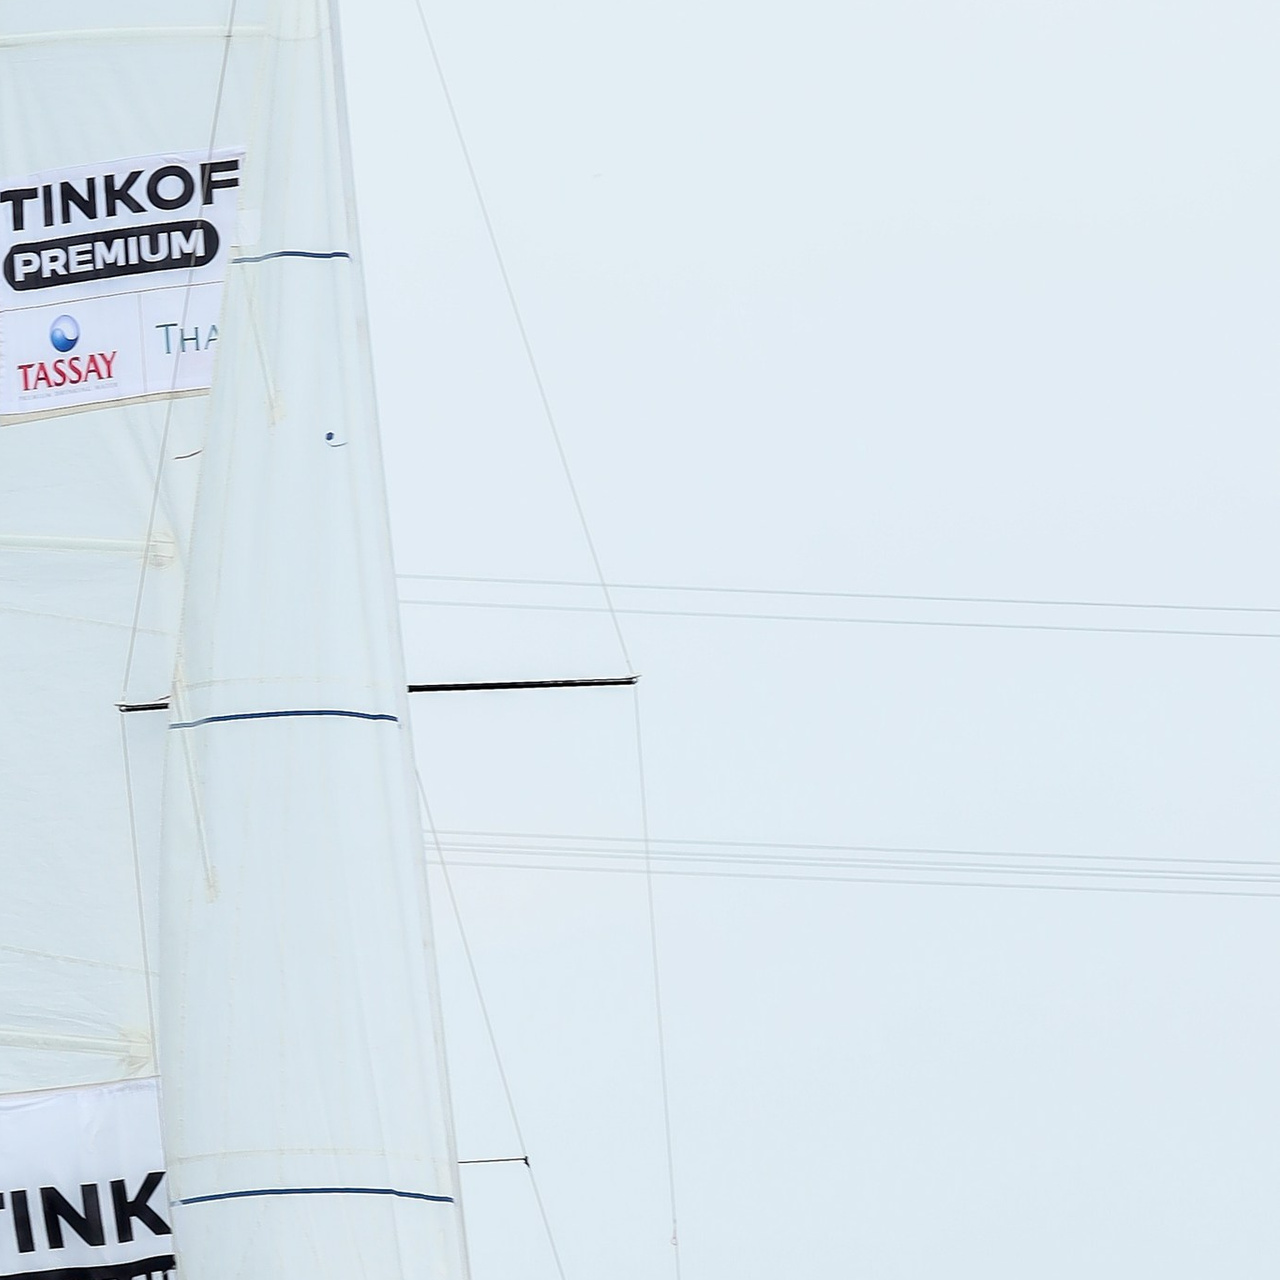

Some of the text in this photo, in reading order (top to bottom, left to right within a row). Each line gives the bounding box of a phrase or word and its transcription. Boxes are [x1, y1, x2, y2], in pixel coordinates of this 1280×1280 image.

[0, 159, 239, 231] TINKOF
[13, 228, 206, 282] PREMIUM
[17, 350, 117, 391] TASSAY
